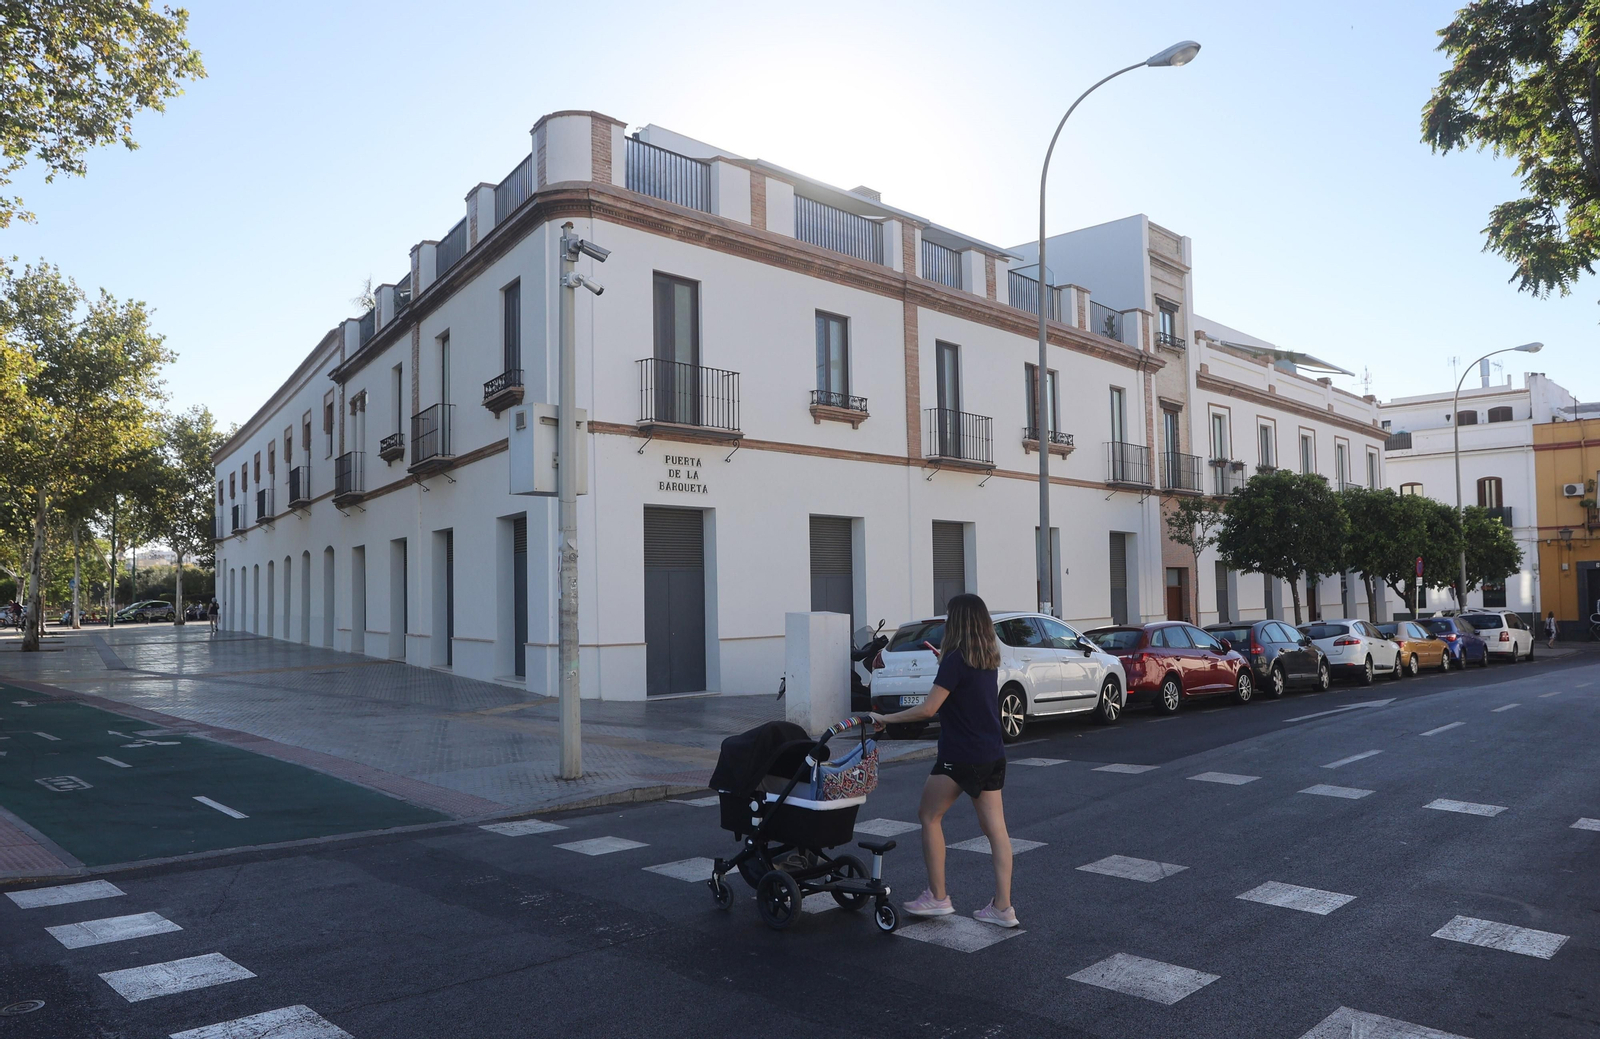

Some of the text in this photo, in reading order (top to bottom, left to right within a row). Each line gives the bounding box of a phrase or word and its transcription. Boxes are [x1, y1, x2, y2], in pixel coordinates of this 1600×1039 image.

[665, 455, 702, 467] PUERTA
[668, 469, 699, 480] DE LA
[659, 481, 708, 494] BARQUETA
[903, 696, 920, 704] 5325
